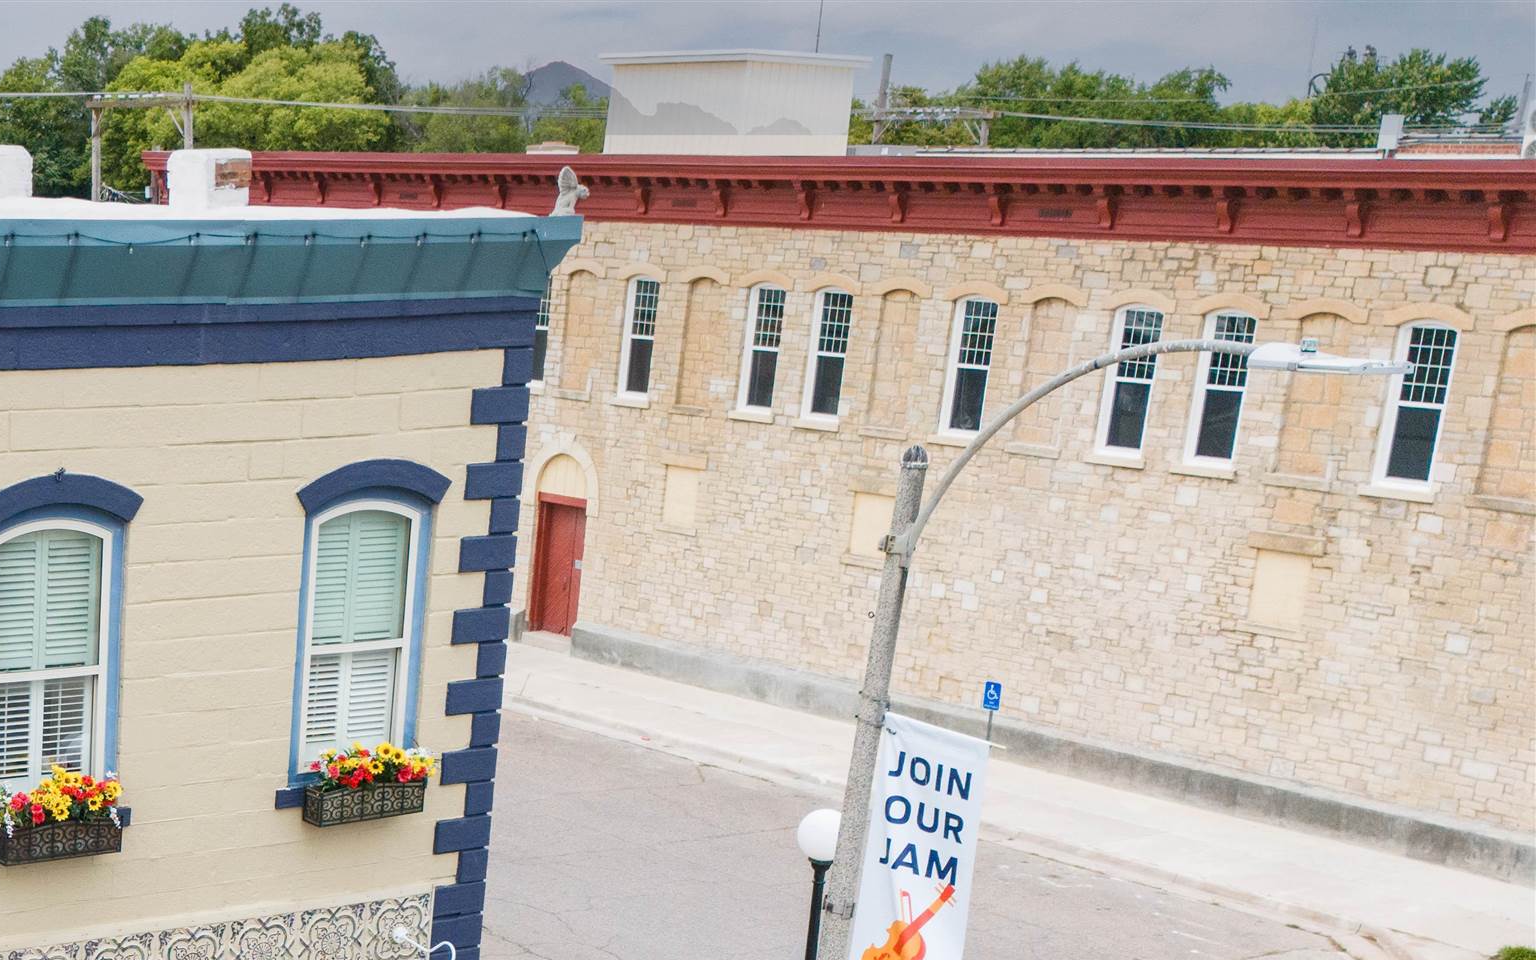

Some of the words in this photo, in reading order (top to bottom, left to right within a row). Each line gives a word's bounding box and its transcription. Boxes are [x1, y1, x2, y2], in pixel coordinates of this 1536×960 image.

[888, 751, 972, 801] JOIN
[885, 795, 964, 844] OUR
[879, 837, 959, 886] JAM
